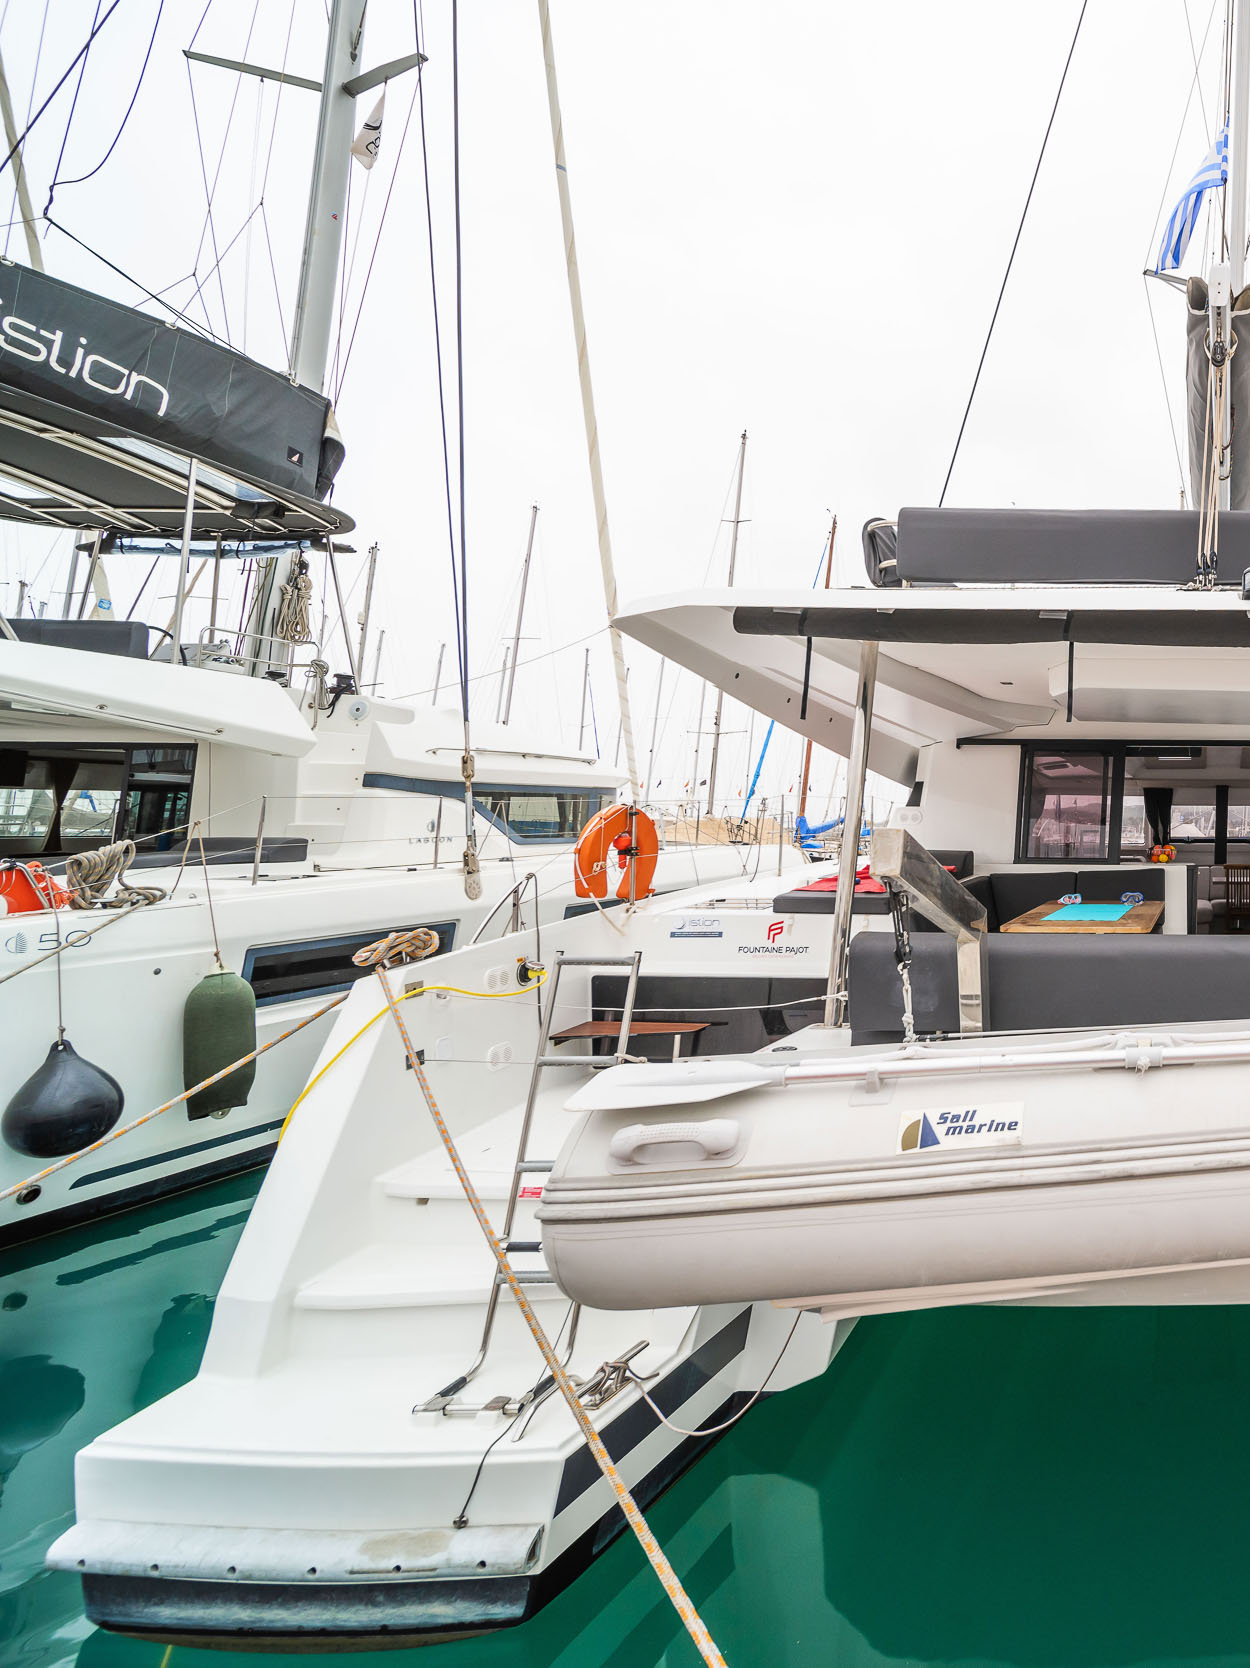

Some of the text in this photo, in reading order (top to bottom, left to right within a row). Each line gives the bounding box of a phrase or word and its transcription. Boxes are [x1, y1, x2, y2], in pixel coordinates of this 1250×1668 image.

[0, 298, 169, 417] stion
[737, 946, 810, 955] FOUNTAINE PAJOT
[944, 1119, 1019, 1136] marine
